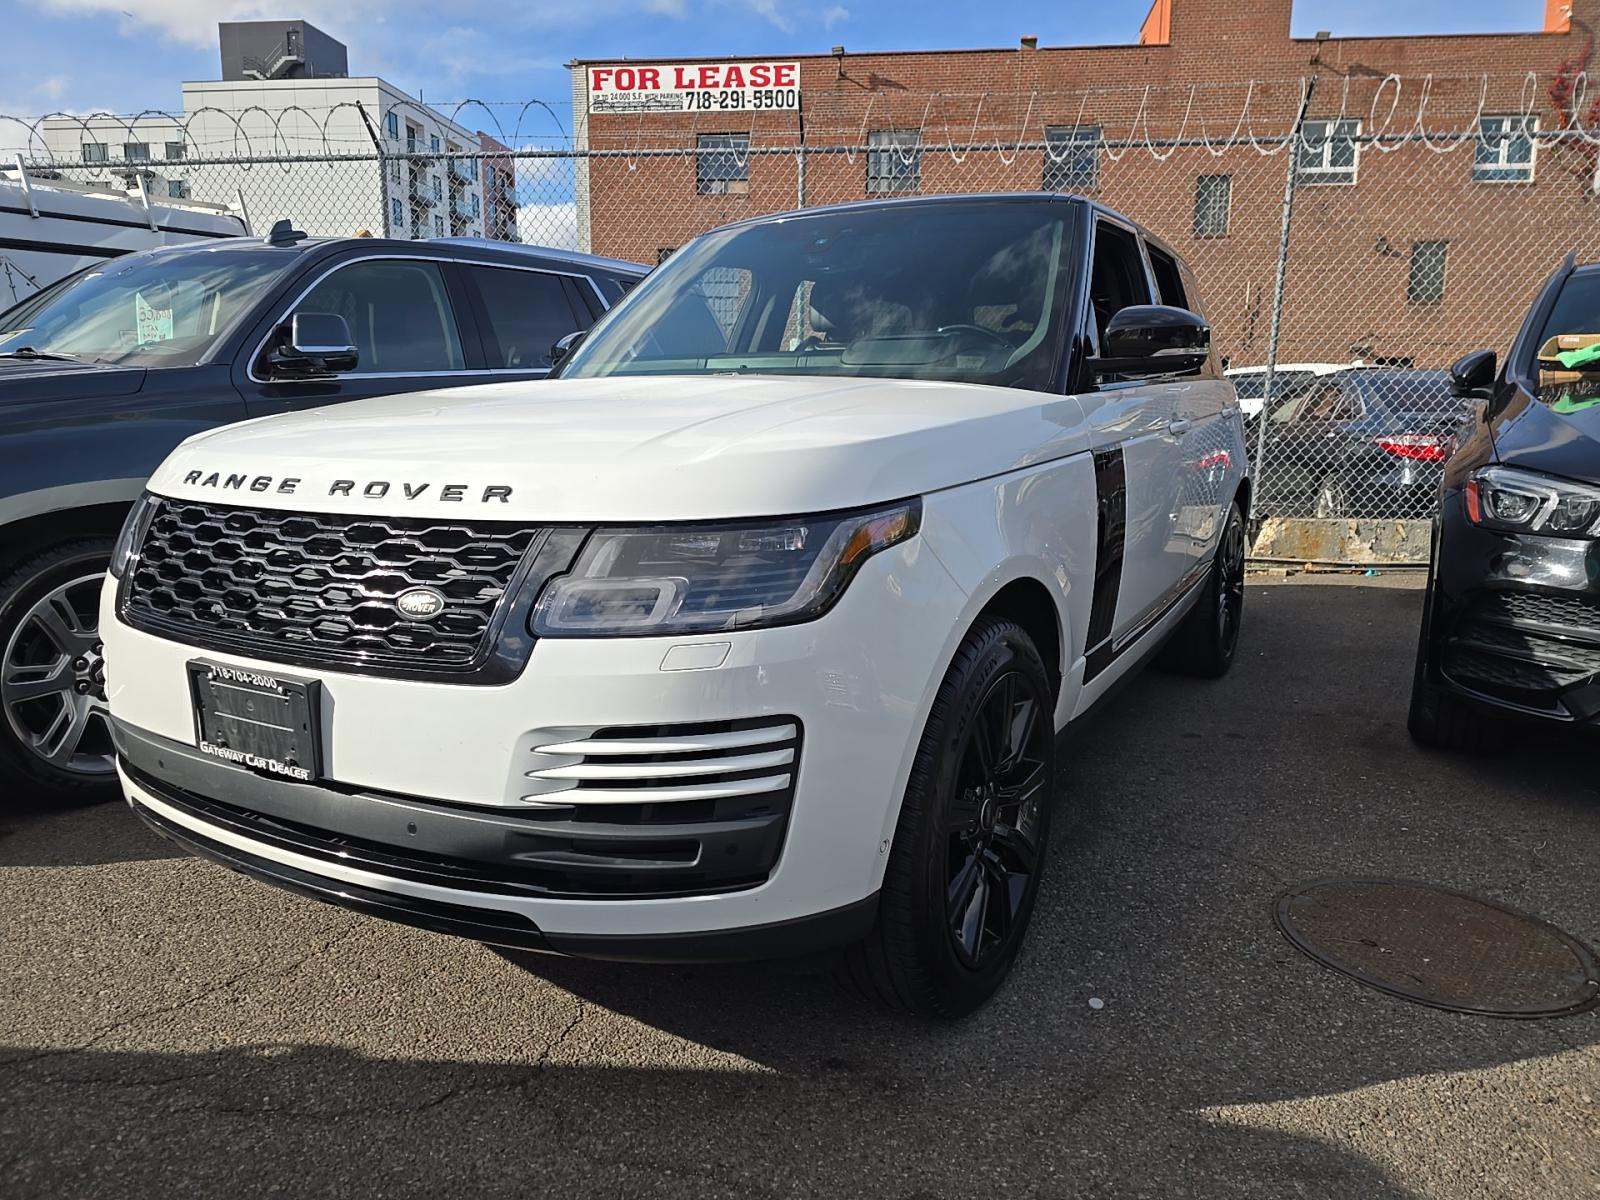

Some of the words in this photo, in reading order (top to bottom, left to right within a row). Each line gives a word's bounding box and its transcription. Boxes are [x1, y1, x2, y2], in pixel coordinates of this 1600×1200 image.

[592, 68, 660, 91] FOR
[674, 65, 795, 89] LEASE
[660, 92, 684, 100] PARKING
[686, 89, 795, 110] 718-291-5500
[183, 470, 301, 494] RANGE
[328, 479, 513, 503] ROVER
[211, 666, 278, 688] 718-704-2000
[246, 753, 267, 770] CAR
